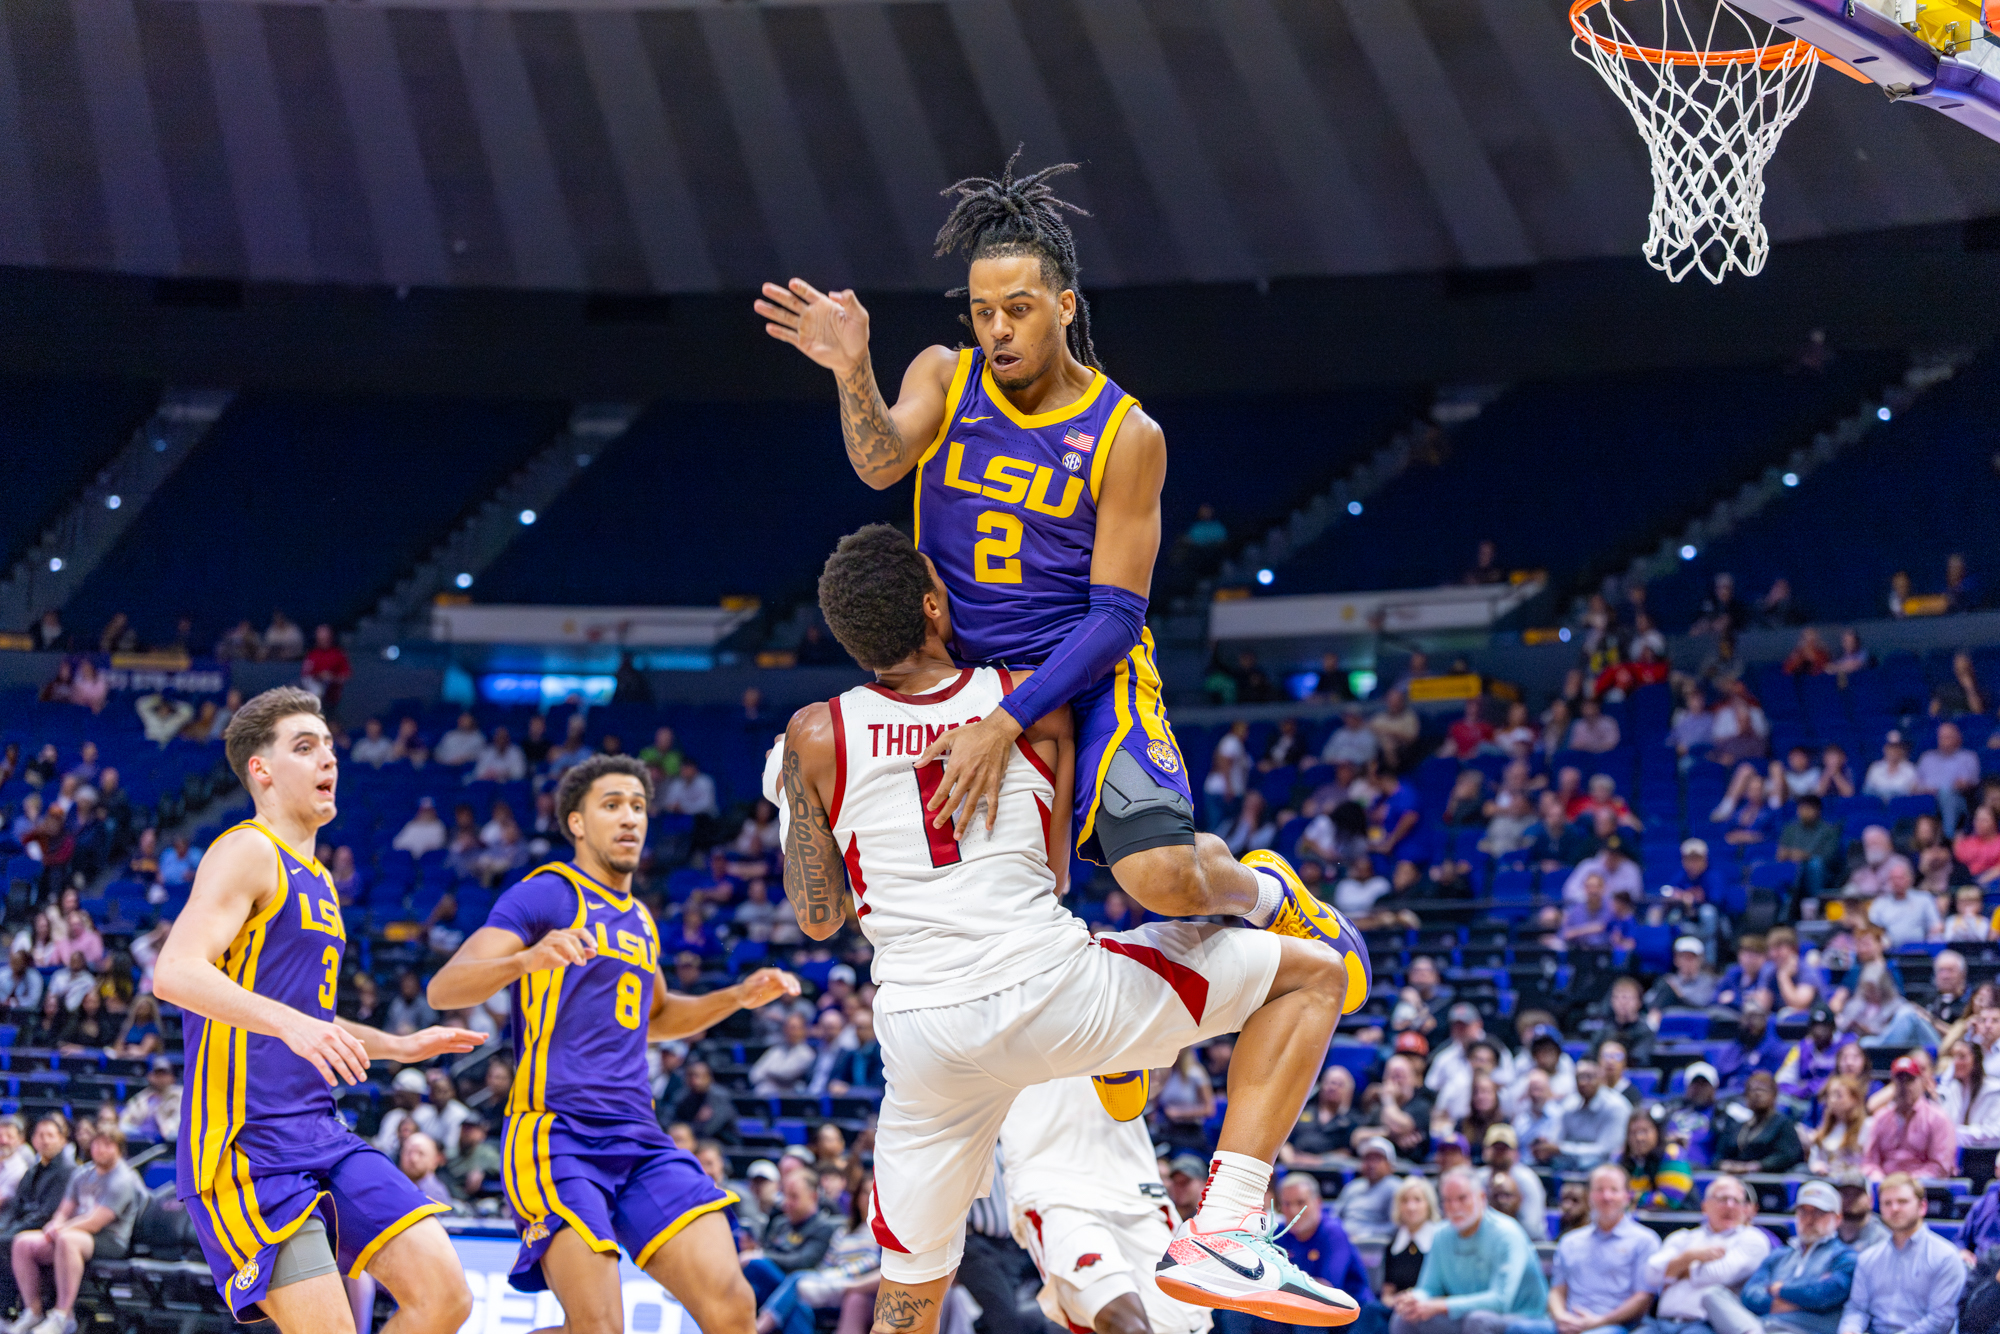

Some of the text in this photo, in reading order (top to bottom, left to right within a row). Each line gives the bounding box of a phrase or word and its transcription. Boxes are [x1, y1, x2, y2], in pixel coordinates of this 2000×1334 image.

[944, 441, 1085, 519] LSU
[1064, 453, 1081, 471] SEC
[974, 510, 1024, 584] 2
[786, 750, 832, 925] GODSPEED
[318, 945, 339, 1010] 3
[595, 922, 656, 974] LSU
[615, 971, 642, 1030] 8
